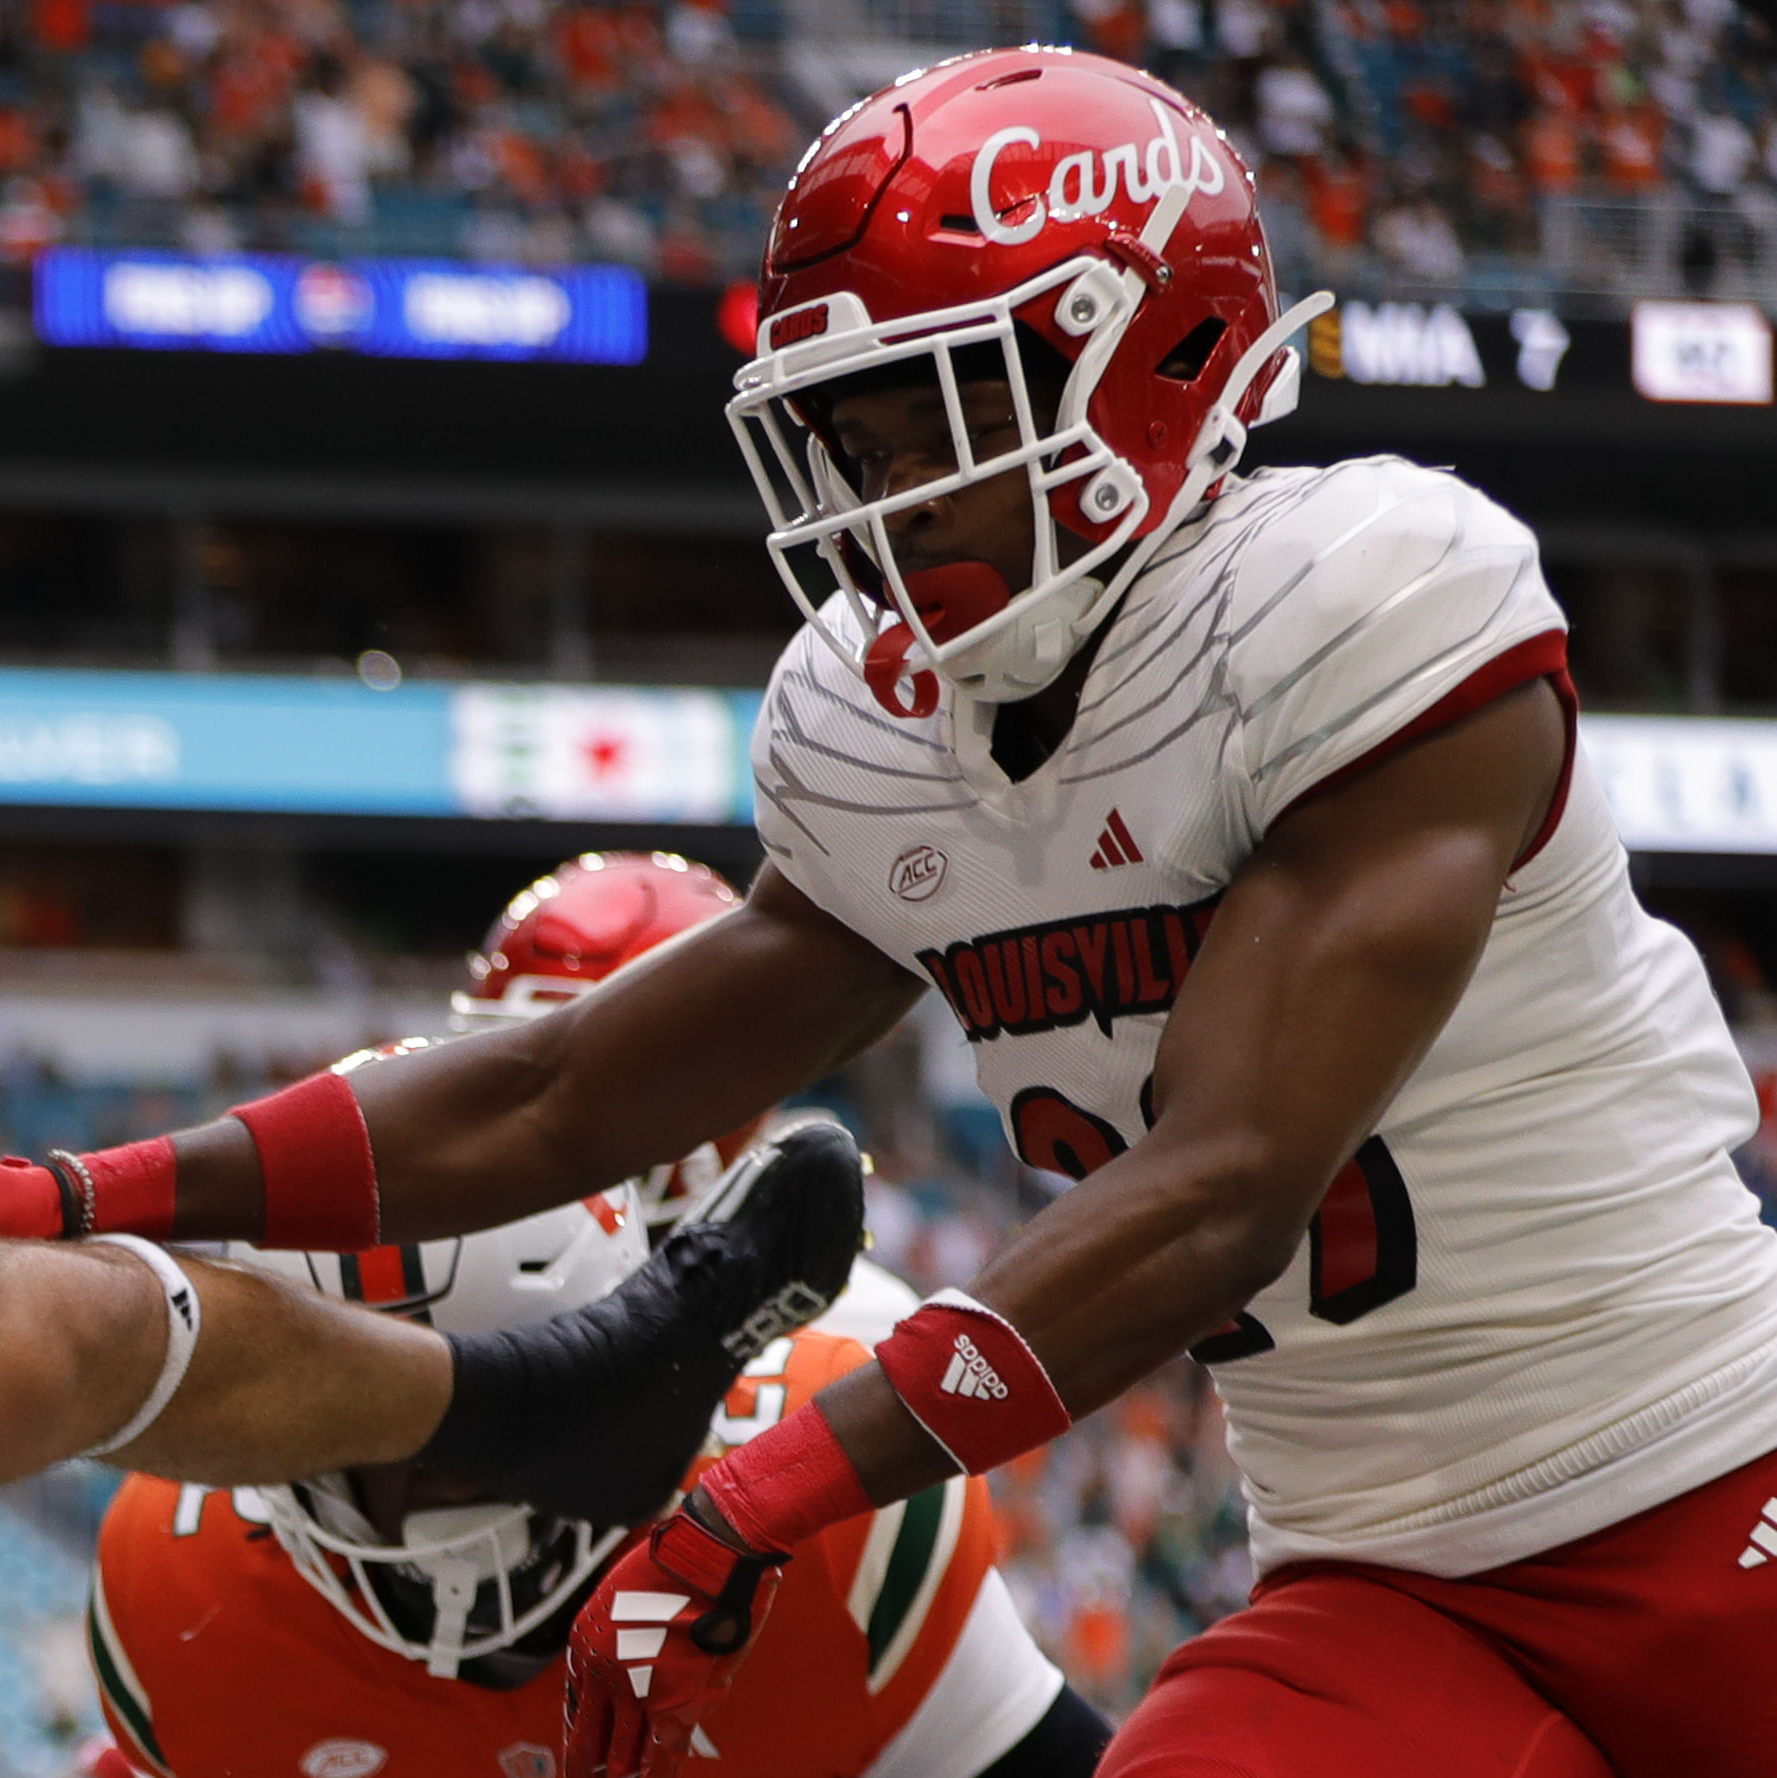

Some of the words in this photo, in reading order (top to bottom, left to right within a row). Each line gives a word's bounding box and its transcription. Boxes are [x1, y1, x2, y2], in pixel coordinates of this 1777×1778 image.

[970, 98, 1224, 246] Cards
[899, 852, 939, 889] ACC
[914, 888, 1229, 1042] LOUISVILL
[953, 1333, 1010, 1400] adidas
